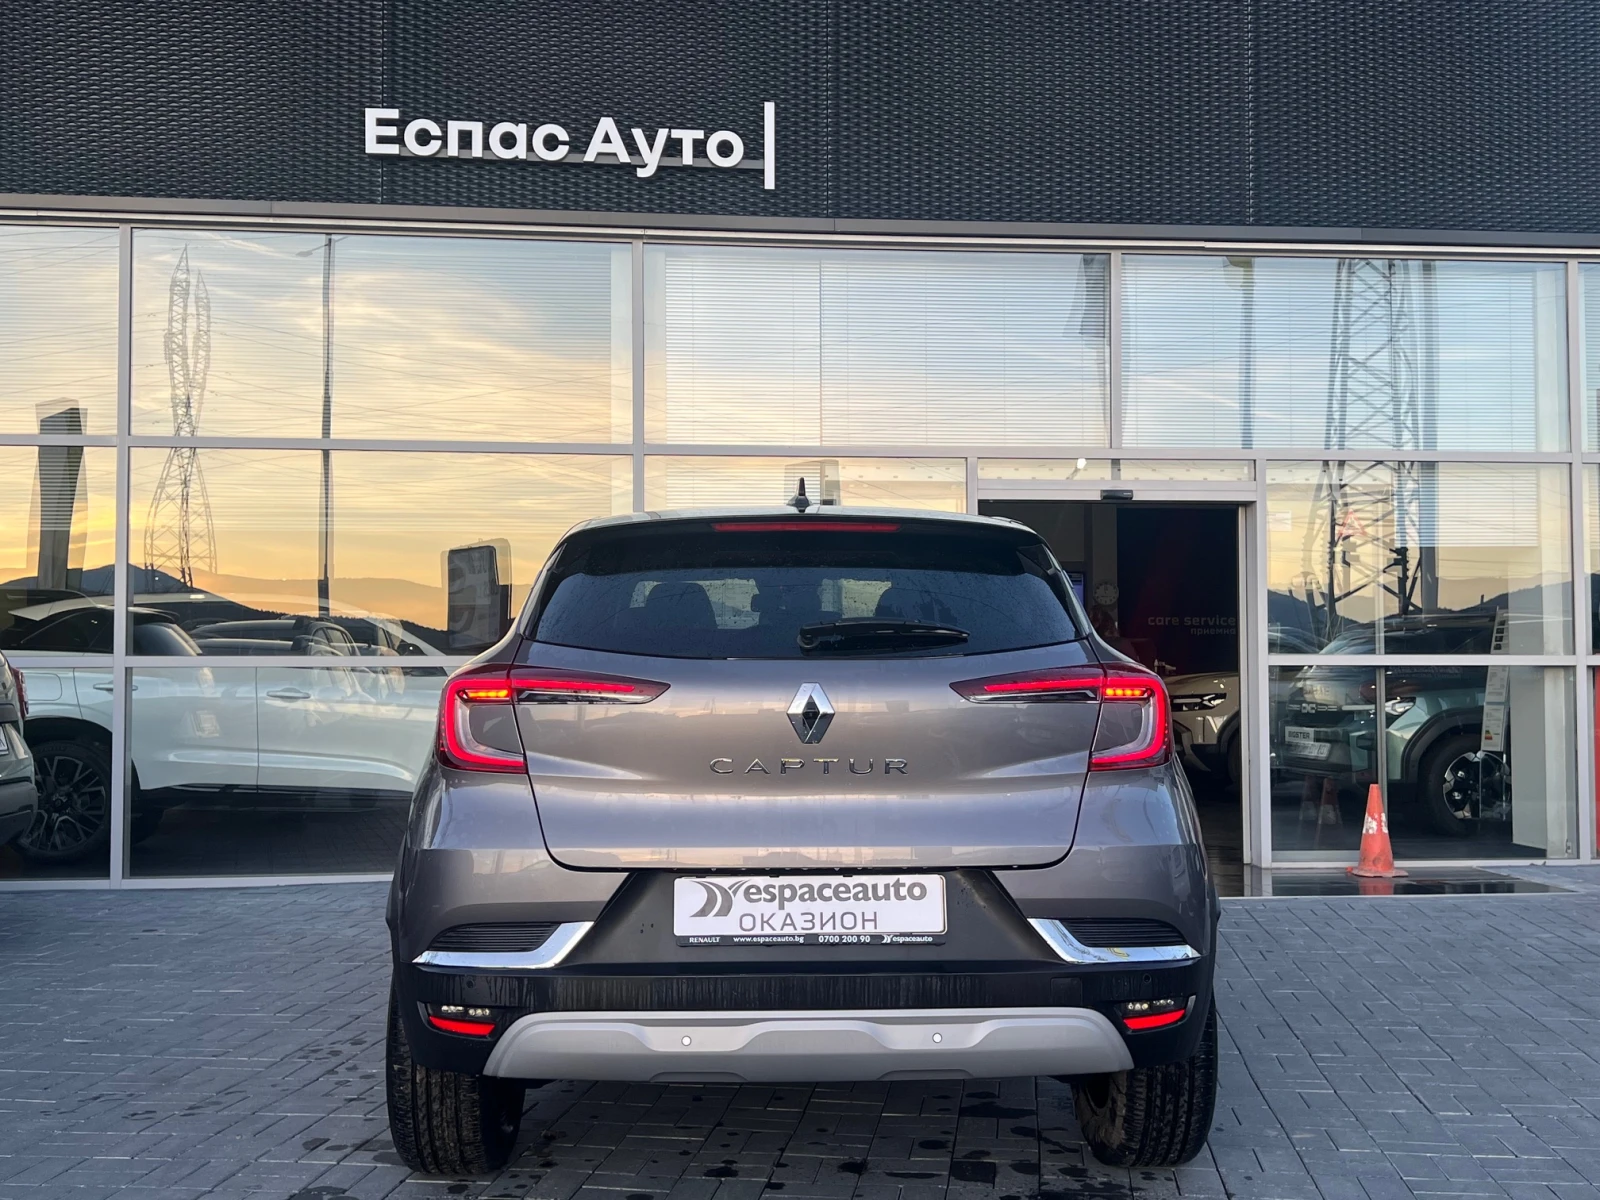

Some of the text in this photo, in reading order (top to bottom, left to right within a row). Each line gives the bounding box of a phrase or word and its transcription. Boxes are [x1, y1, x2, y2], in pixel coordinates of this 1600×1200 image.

[364, 107, 744, 178] Еспас Ауто
[1147, 614, 1236, 626] care service
[709, 757, 909, 775] CAPTUR
[743, 878, 927, 910] espaceauto
[738, 911, 878, 932] ОКАЗИОН
[733, 935, 805, 944] www.espaceauto.bg
[818, 935, 840, 943] 0700
[841, 935, 858, 943] 200
[859, 935, 871, 943] 90
[892, 935, 933, 944] espaceauto
